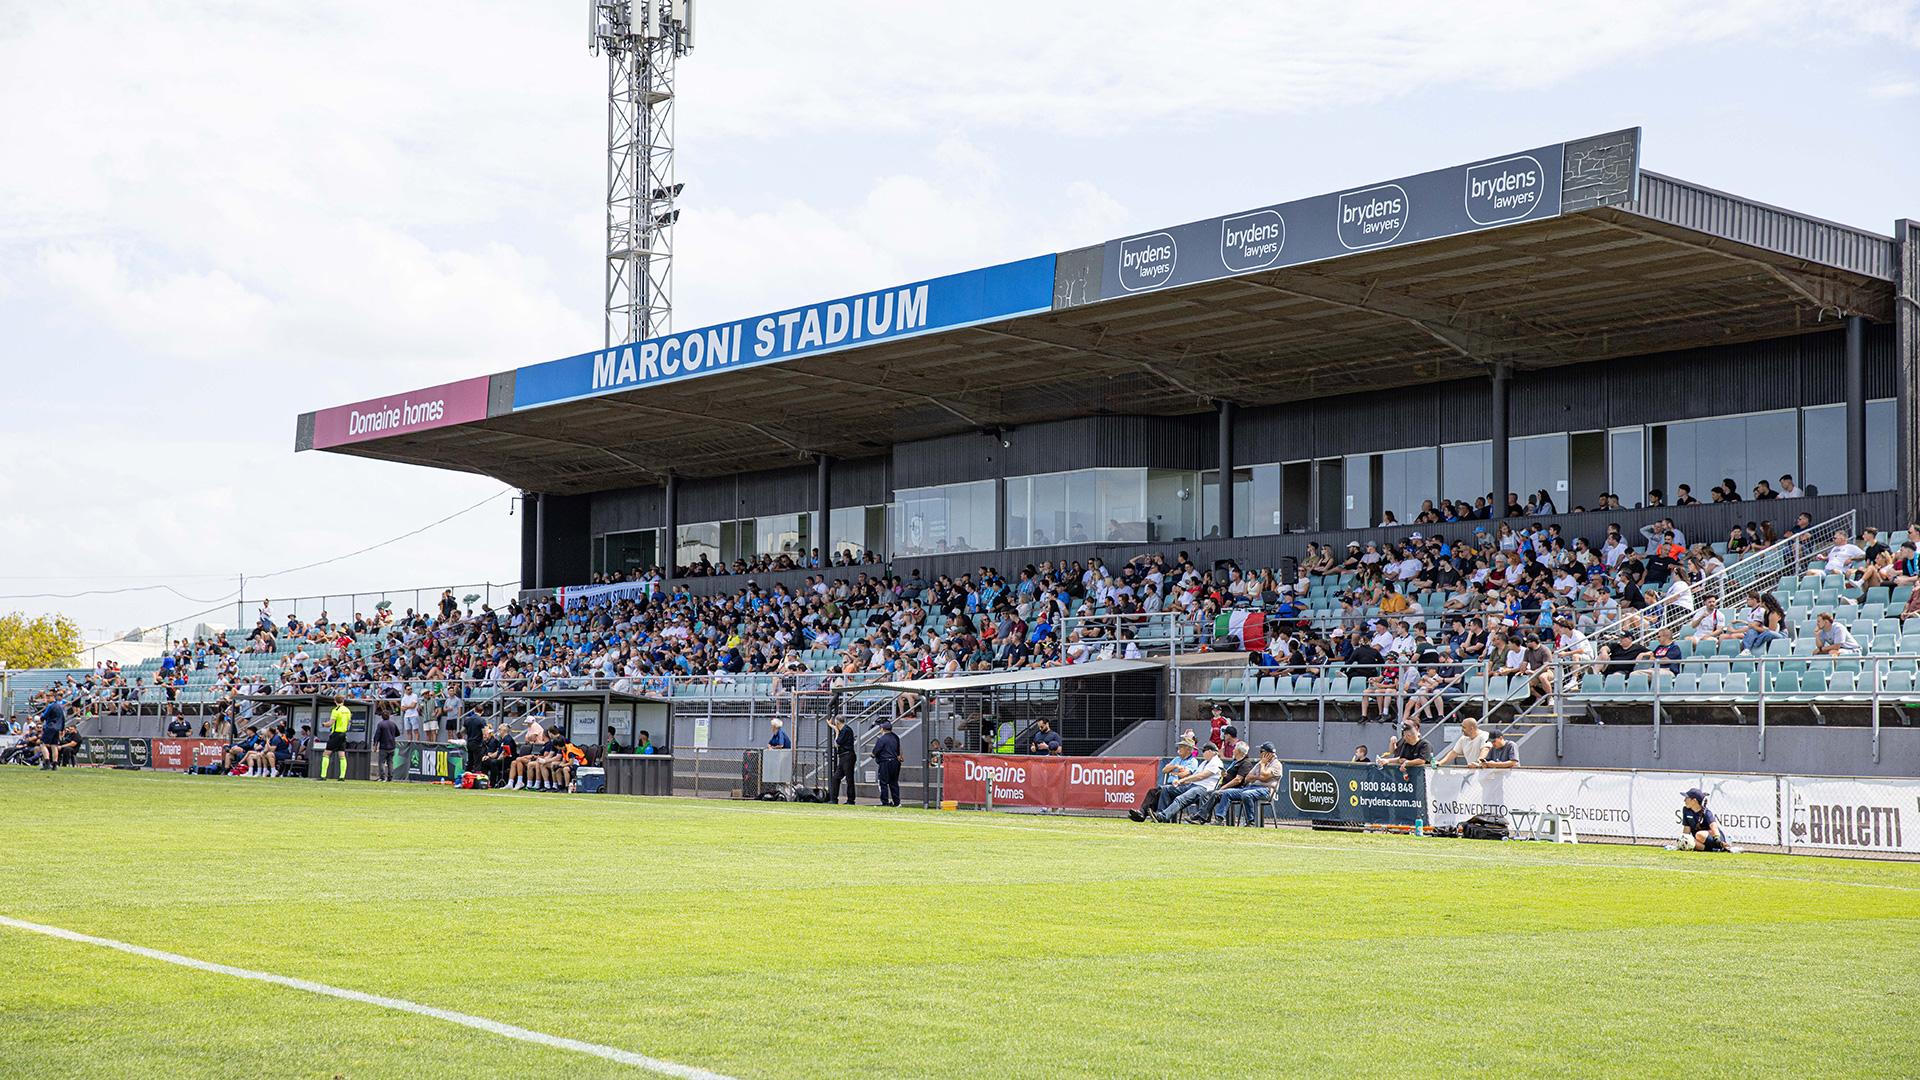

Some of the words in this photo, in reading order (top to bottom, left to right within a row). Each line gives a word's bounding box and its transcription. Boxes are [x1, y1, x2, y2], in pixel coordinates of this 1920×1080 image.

[1471, 168, 1536, 200] brydens
[1493, 191, 1535, 211] lawyers
[1343, 196, 1401, 226] brydens
[1362, 218, 1400, 235] lawyers
[1226, 223, 1279, 249] brydens
[1123, 245, 1171, 270] brydens
[1244, 242, 1277, 259] lawyers
[1139, 263, 1170, 278] lawyers
[591, 324, 742, 389] MARCONI
[753, 285, 929, 357] STADIUM
[349, 405, 400, 435] Domaine
[402, 399, 444, 425] homes
[159, 742, 181, 755] Domaine
[200, 742, 222, 755] Domaine
[964, 760, 1026, 784] Domaine
[1070, 764, 1136, 786] Domaine
[993, 785, 1025, 800] homes
[1292, 777, 1334, 796] brydens
[1360, 781, 1379, 792] 1800
[1380, 782, 1396, 792] 848
[1397, 782, 1414, 793] 848
[1104, 789, 1135, 803] homes
[1308, 793, 1335, 805] lawyers
[1360, 795, 1422, 808] brydens.com.au
